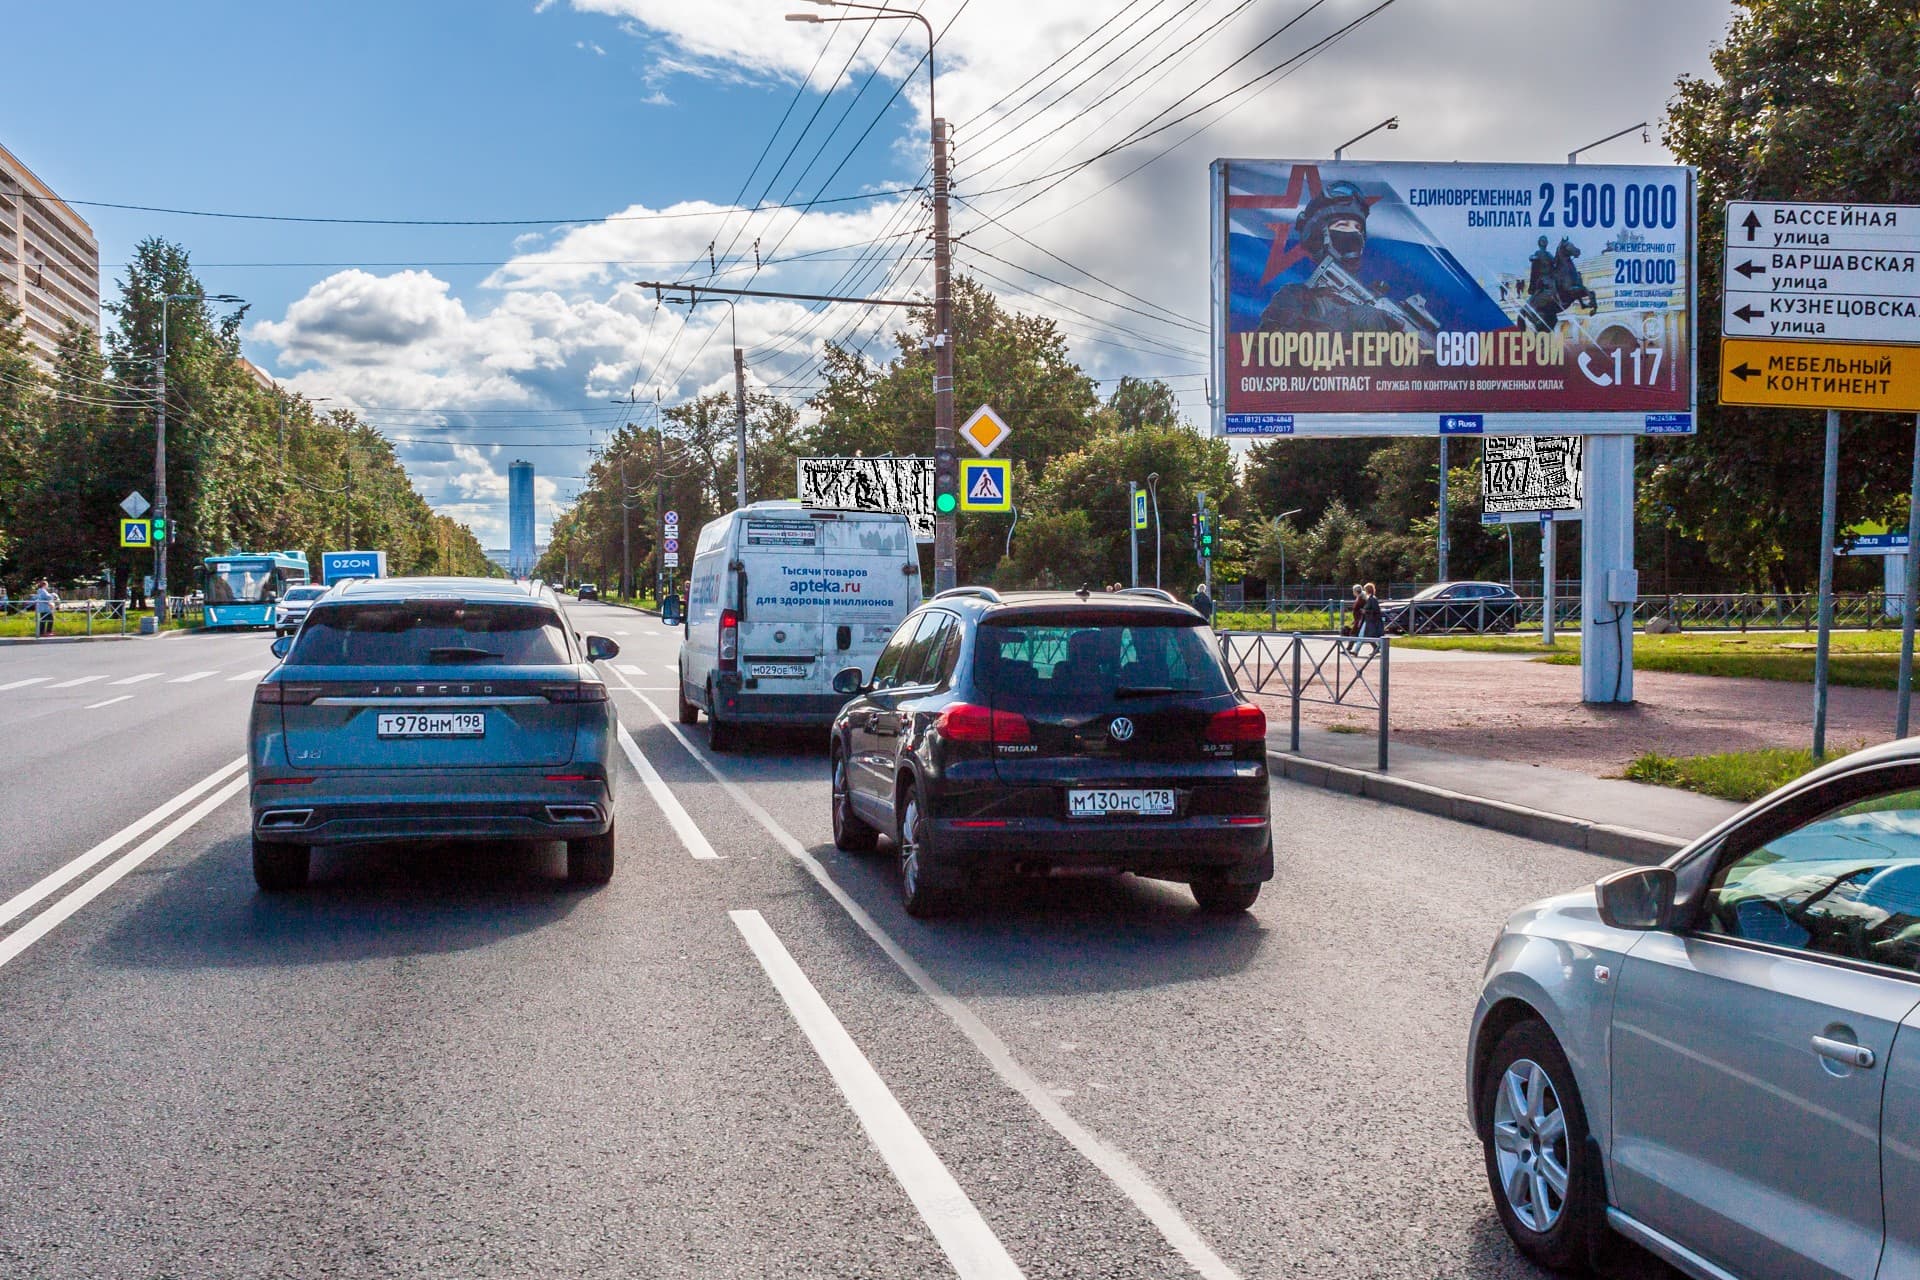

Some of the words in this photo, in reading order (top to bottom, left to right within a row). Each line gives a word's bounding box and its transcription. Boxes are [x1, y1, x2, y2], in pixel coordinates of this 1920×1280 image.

[1410, 188, 1532, 207] ЕДИНОВРЕМЕННАЯ
[1538, 182, 1555, 228] 2
[1563, 183, 1616, 228] 500
[1624, 184, 1677, 229] 000
[1468, 211, 1532, 227] ВЫПЛАТА
[1774, 205, 1897, 227] БАССЕЙНАЯ
[1774, 232, 1830, 246] улица
[1615, 242, 1665, 253] ЕЖЕМЕСЯЧНО
[1667, 243, 1676, 253] ОТ
[1772, 254, 1915, 272] ВАРШАВСКАЯ
[1615, 259, 1641, 284] 210
[1645, 259, 1676, 284] 000
[1772, 277, 1828, 291] улица
[1770, 298, 1920, 317] КУЗНЕЦОВСКА
[1770, 320, 1825, 335] улица
[1240, 331, 1254, 367] У
[1436, 331, 1493, 366] СВОИ
[1499, 331, 1565, 366] ГЕРОИ
[1611, 348, 1663, 385] 117
[1768, 355, 1891, 376] МЕБЕЛЬНЫЙ
[1241, 376, 1371, 392] GOV.SPB.RU/CONTRACT
[1376, 380, 1410, 391] СЛУЖБА
[1411, 380, 1422, 391] ПО
[1424, 380, 1469, 391] КОНТРАКТУ
[1470, 380, 1475, 390] В
[1477, 380, 1536, 391] ВООРУЖЕННЫХ
[1538, 379, 1564, 390] СИЛАХ
[1767, 376, 1890, 395] КОНТИНЕНТ
[1458, 420, 1477, 428] Russ
[333, 559, 370, 569] OZON
[781, 566, 822, 576] Тысячи
[823, 568, 868, 578] товаров
[790, 579, 861, 594] apteka.ru
[756, 597, 777, 606] для
[780, 597, 830, 607] здоровья
[833, 598, 894, 607] миллионов
[371, 685, 492, 694] JAECOO
[455, 715, 480, 727] 198
[1145, 791, 1170, 804] 178
